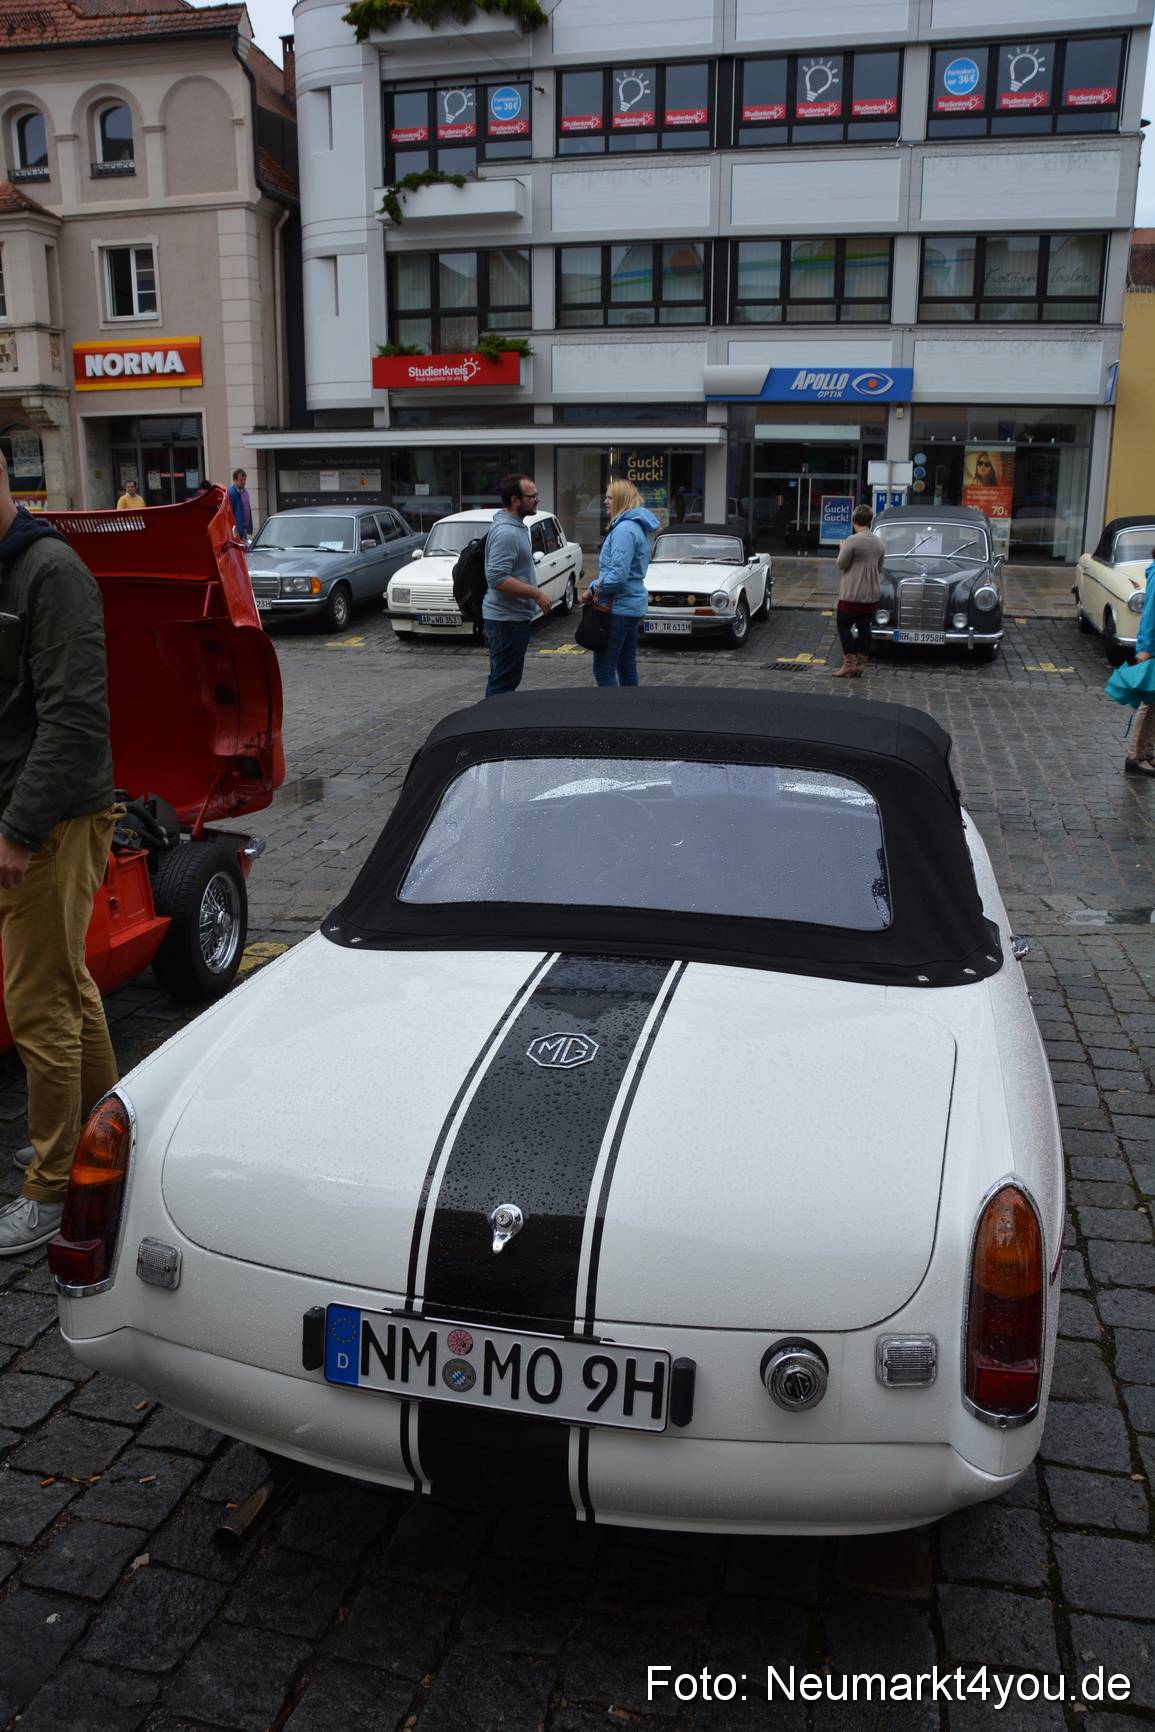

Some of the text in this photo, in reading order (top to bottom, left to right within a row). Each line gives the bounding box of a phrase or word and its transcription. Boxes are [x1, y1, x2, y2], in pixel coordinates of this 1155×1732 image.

[85, 350, 185, 377] NORMA
[408, 365, 468, 378] Studienkreis
[628, 456, 663, 468] Guck!
[628, 468, 663, 480] Guck!
[824, 504, 850, 513] Guck!
[824, 514, 849, 522] Guck!
[900, 632, 909, 640] RH
[921, 634, 944, 642] 1958H
[538, 1037, 588, 1064] MG
[337, 1352, 349, 1369] D
[360, 1319, 438, 1387] NM
[483, 1337, 563, 1404] MO
[582, 1355, 664, 1420] 9H
